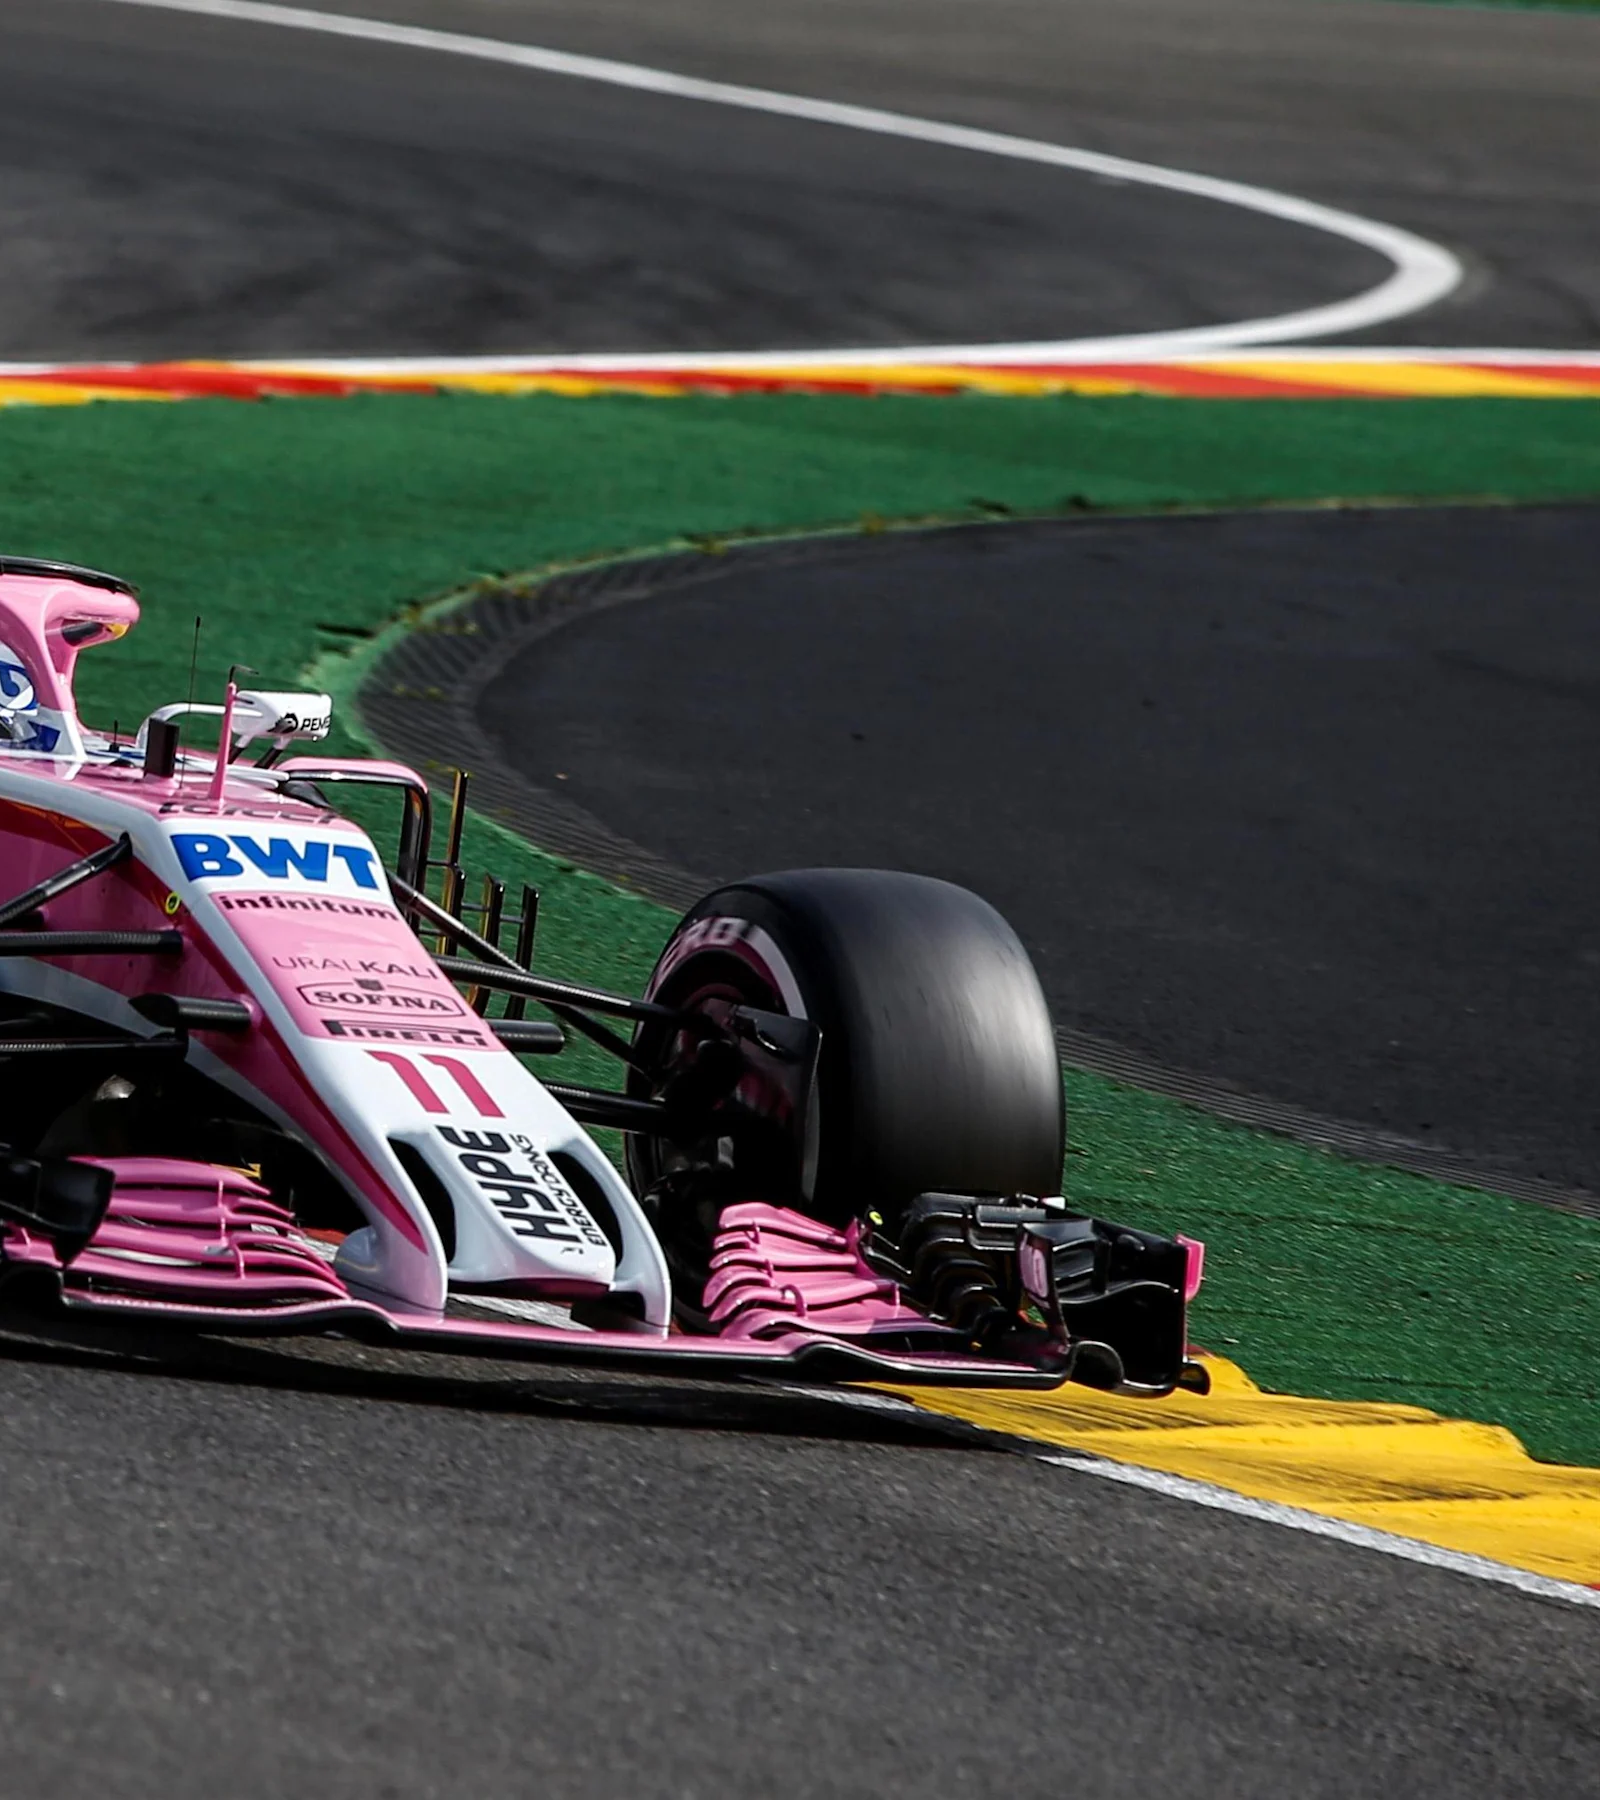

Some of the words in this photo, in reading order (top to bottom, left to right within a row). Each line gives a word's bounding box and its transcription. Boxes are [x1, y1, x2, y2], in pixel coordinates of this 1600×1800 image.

[170, 833, 379, 890] BWT
[219, 895, 400, 922] infinitum
[272, 956, 440, 980] URALKALI
[313, 990, 453, 1013] SOFINA
[320, 1019, 489, 1047] PIRELLI
[363, 1049, 507, 1118] 11
[434, 1125, 584, 1244] HYPE
